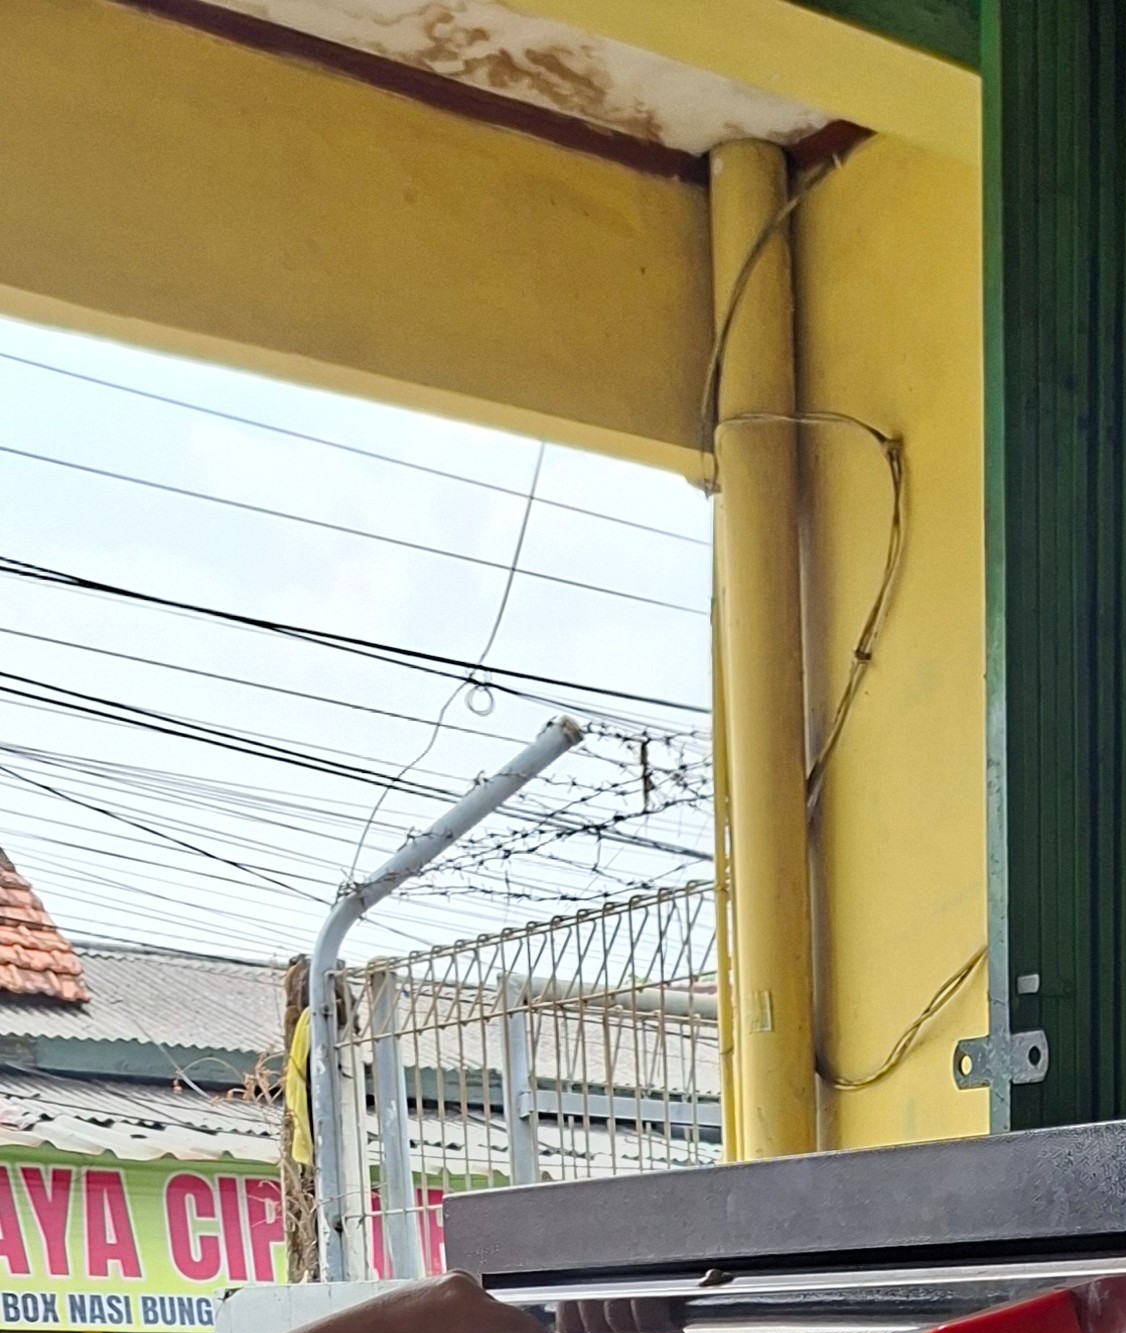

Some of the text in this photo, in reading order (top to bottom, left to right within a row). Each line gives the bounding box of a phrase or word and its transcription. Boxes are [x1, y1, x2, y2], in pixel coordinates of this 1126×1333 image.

[2, 1292, 214, 1326] BOX NASI BUNG
